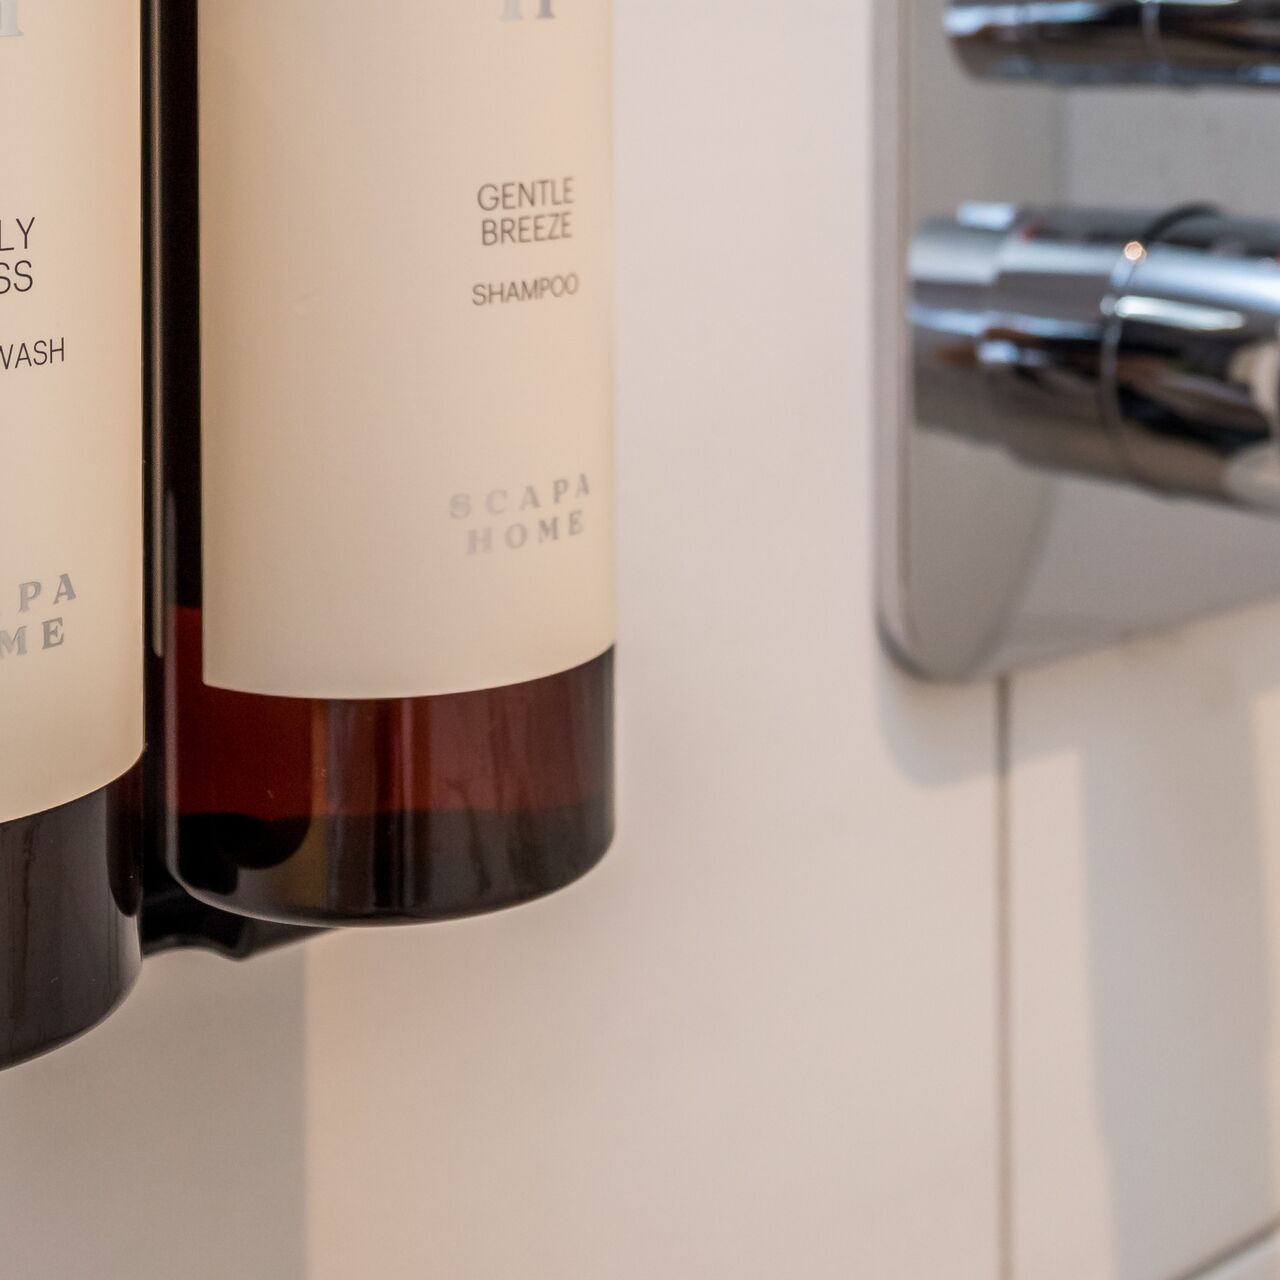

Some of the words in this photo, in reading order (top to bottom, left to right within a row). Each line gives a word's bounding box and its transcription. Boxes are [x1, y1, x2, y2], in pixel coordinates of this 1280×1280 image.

[477, 176, 575, 212] GENTLE
[481, 211, 573, 247] BREEZE
[472, 273, 580, 307] SHAMPOO
[448, 472, 591, 520] SCAPA
[467, 509, 584, 556] HOME
